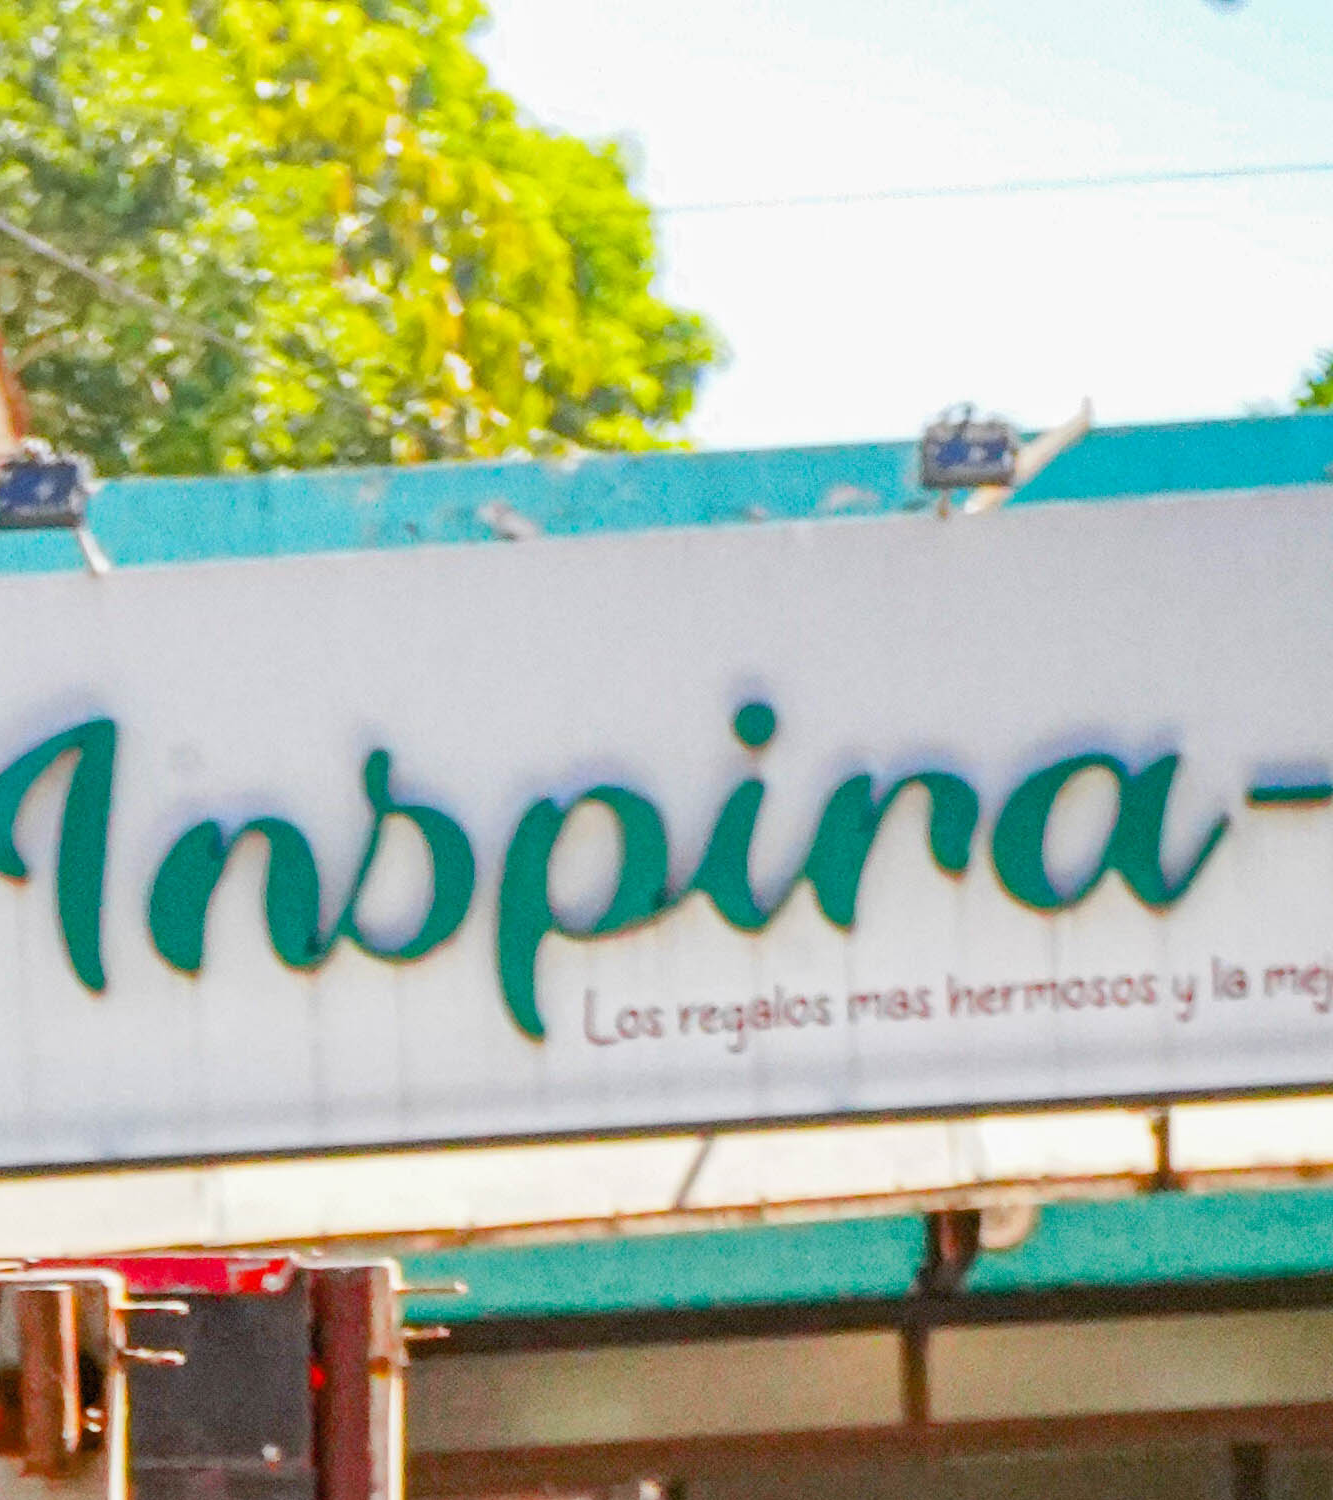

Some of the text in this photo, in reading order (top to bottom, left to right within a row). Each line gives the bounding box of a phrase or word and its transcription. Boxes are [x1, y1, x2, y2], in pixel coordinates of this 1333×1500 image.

[583, 989, 663, 1046] Los
[678, 986, 831, 1053] regalos
[847, 977, 932, 1021] mas
[945, 971, 1158, 1018] hermosos
[1172, 979, 1196, 1020] y
[1210, 956, 1247, 1000] la
